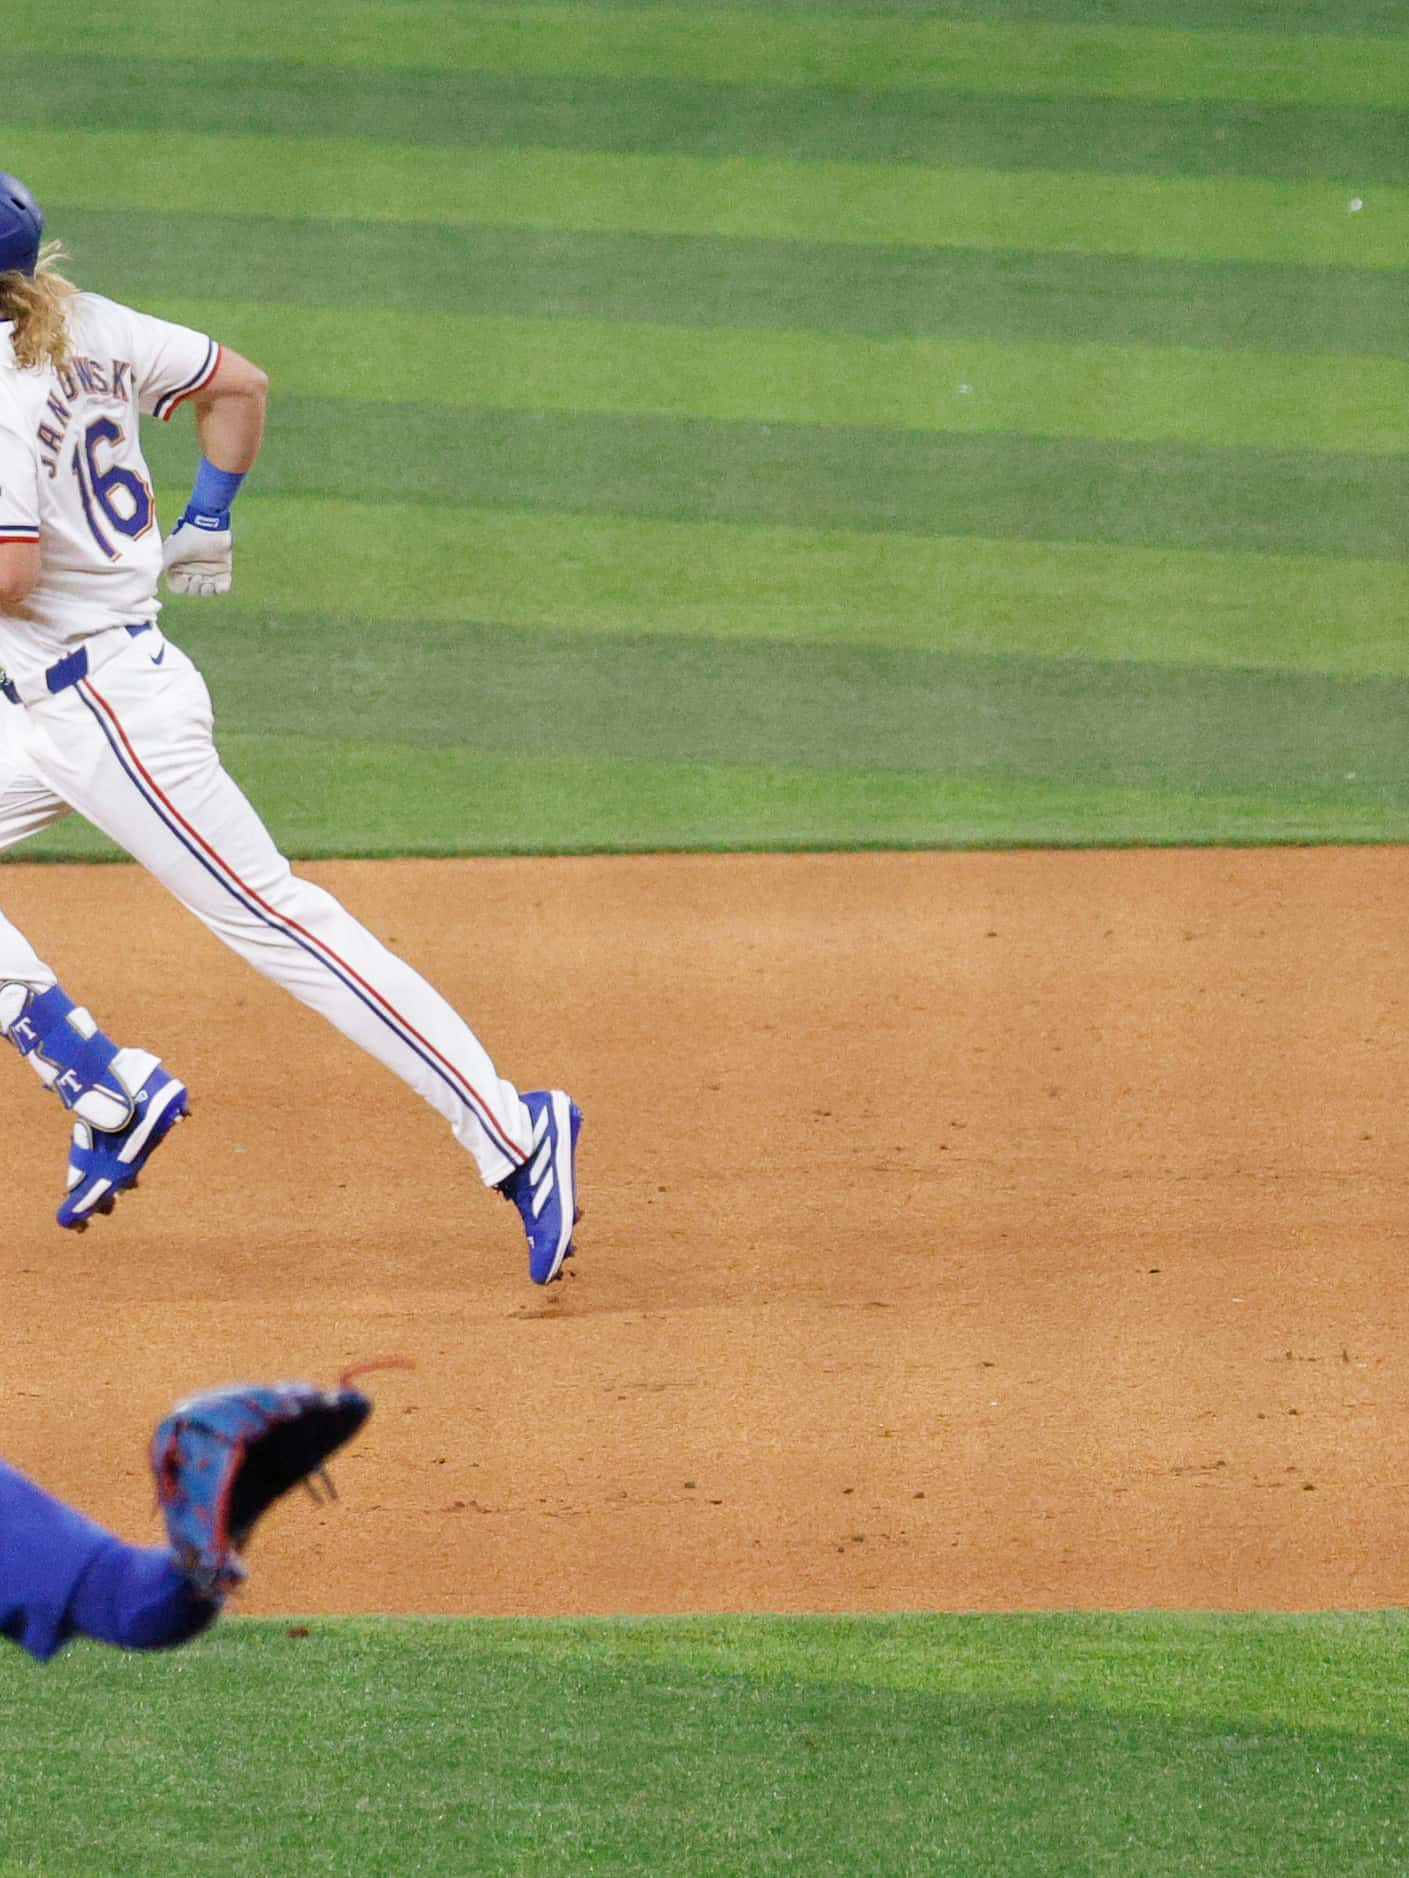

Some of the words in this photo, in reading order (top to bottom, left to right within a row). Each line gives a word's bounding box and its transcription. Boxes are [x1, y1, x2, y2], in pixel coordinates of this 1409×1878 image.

[72, 415, 155, 562] 16
[14, 1016, 37, 1040] T
[57, 1068, 82, 1092] T
